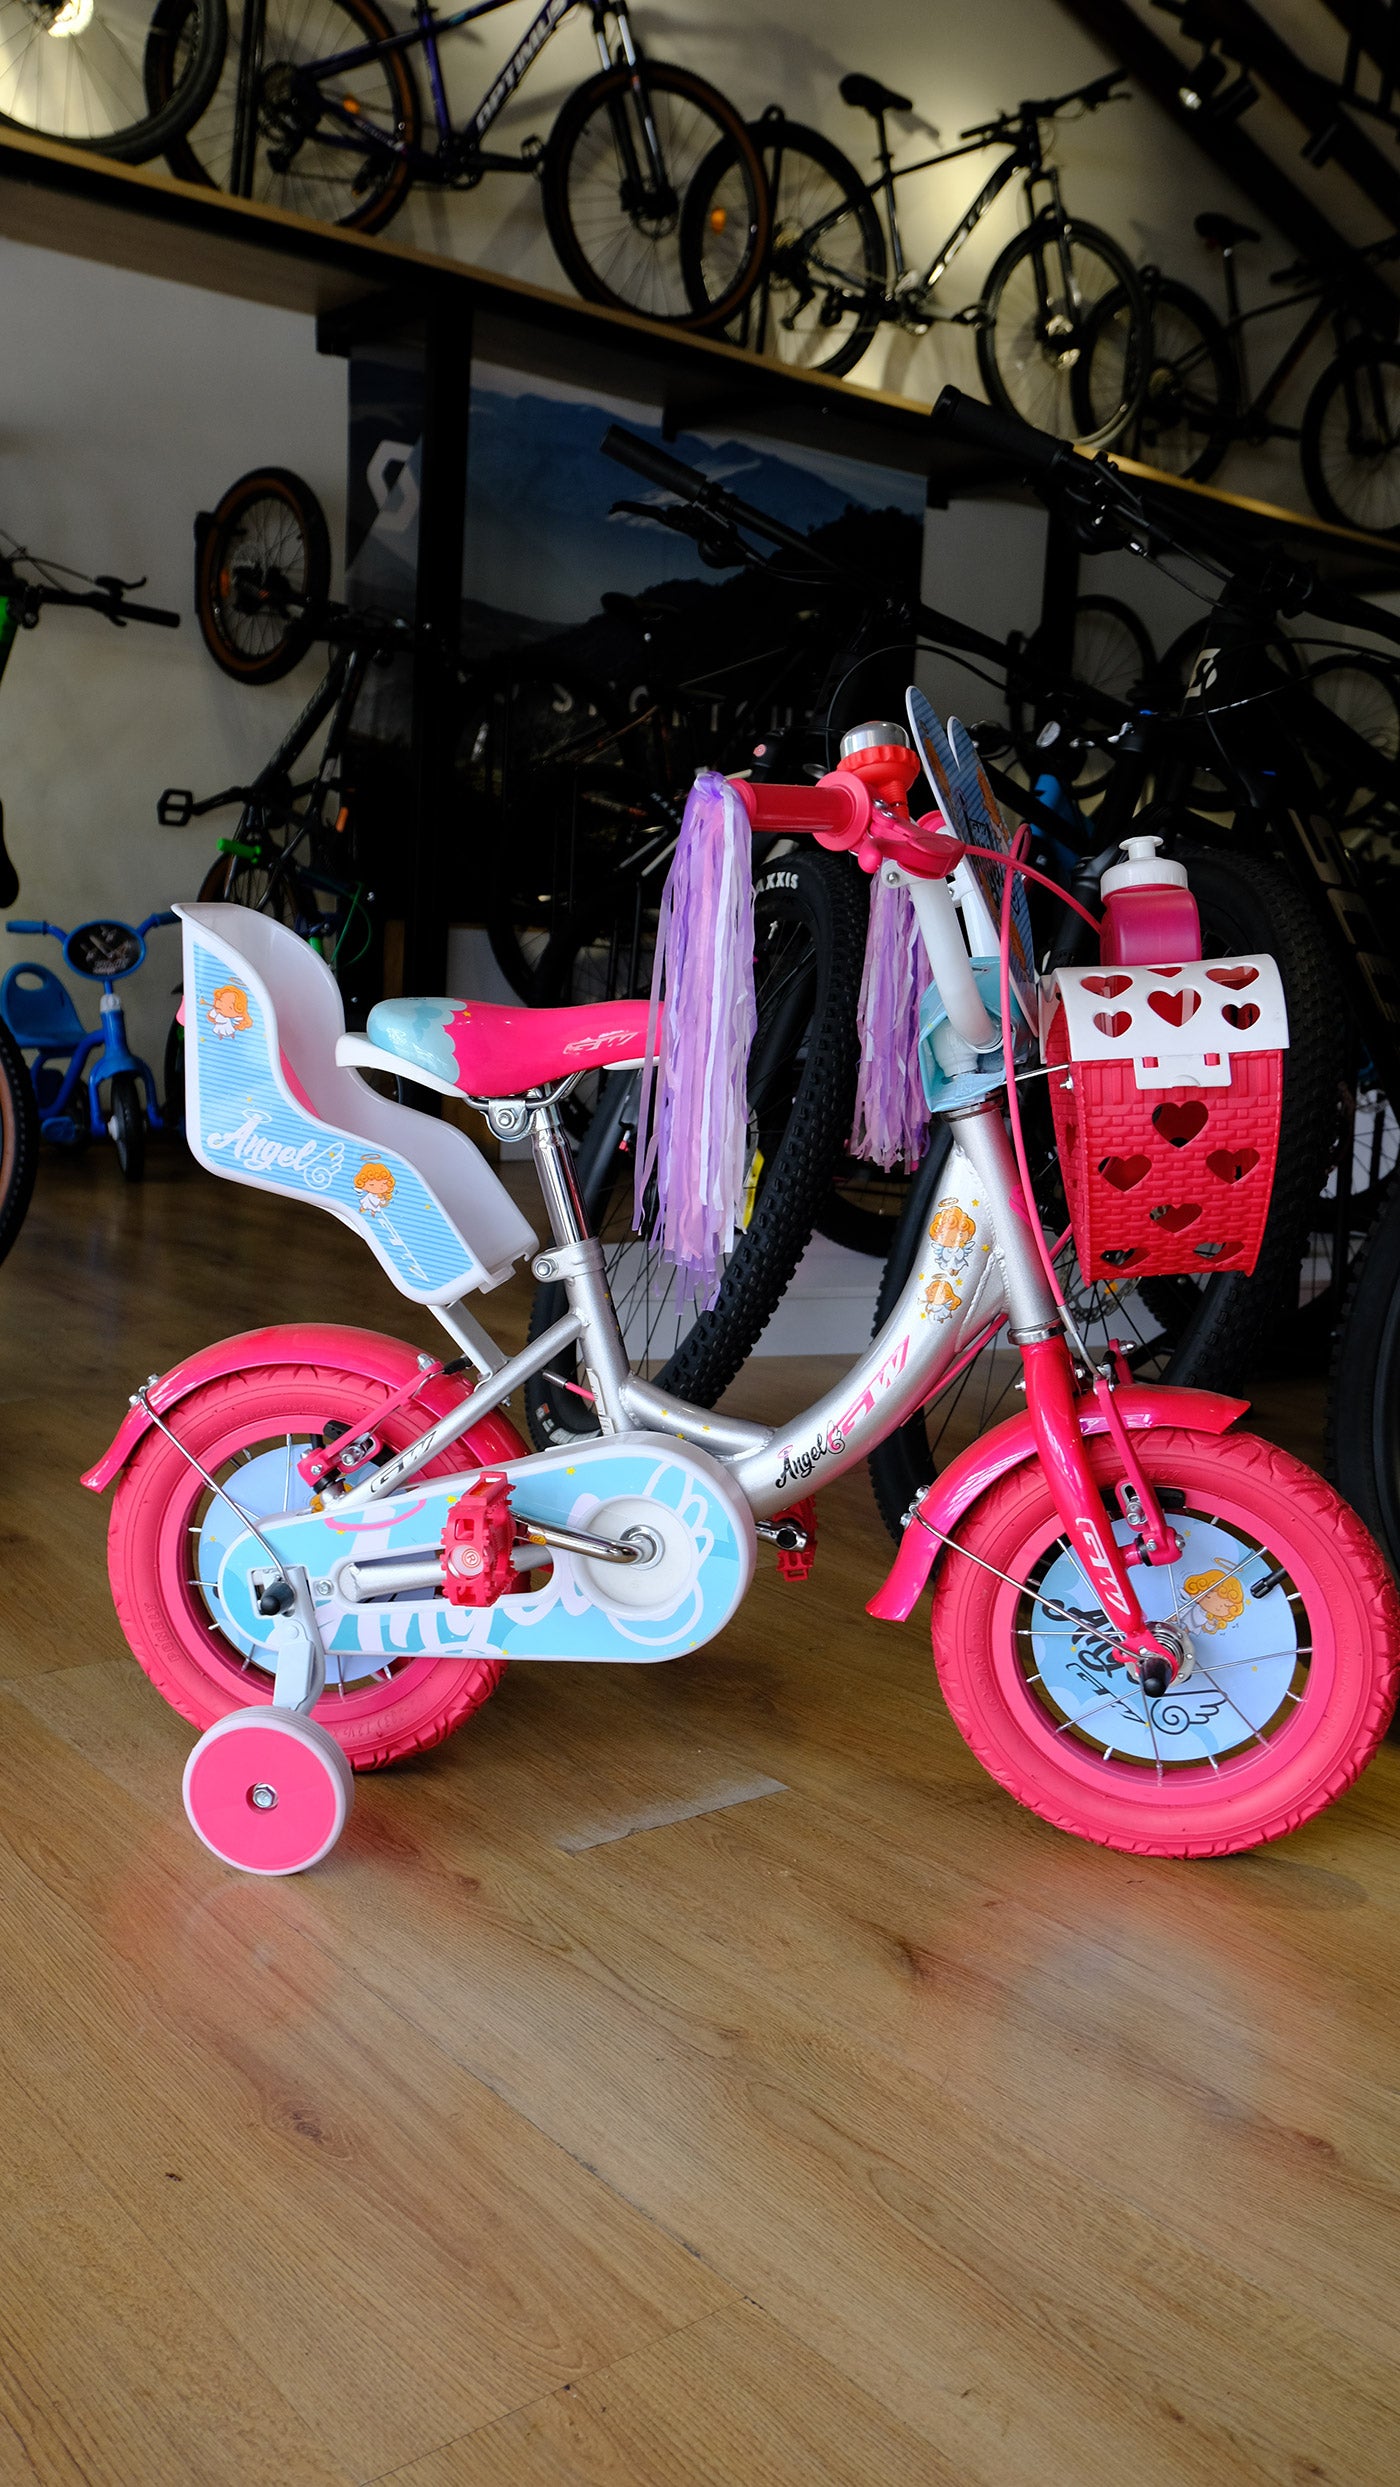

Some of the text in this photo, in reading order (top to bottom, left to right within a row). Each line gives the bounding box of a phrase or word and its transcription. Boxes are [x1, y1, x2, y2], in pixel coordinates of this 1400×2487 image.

[756, 871, 799, 892] AXXIS
[206, 1111, 318, 1171] Angel
[775, 1433, 828, 1489] Angel
